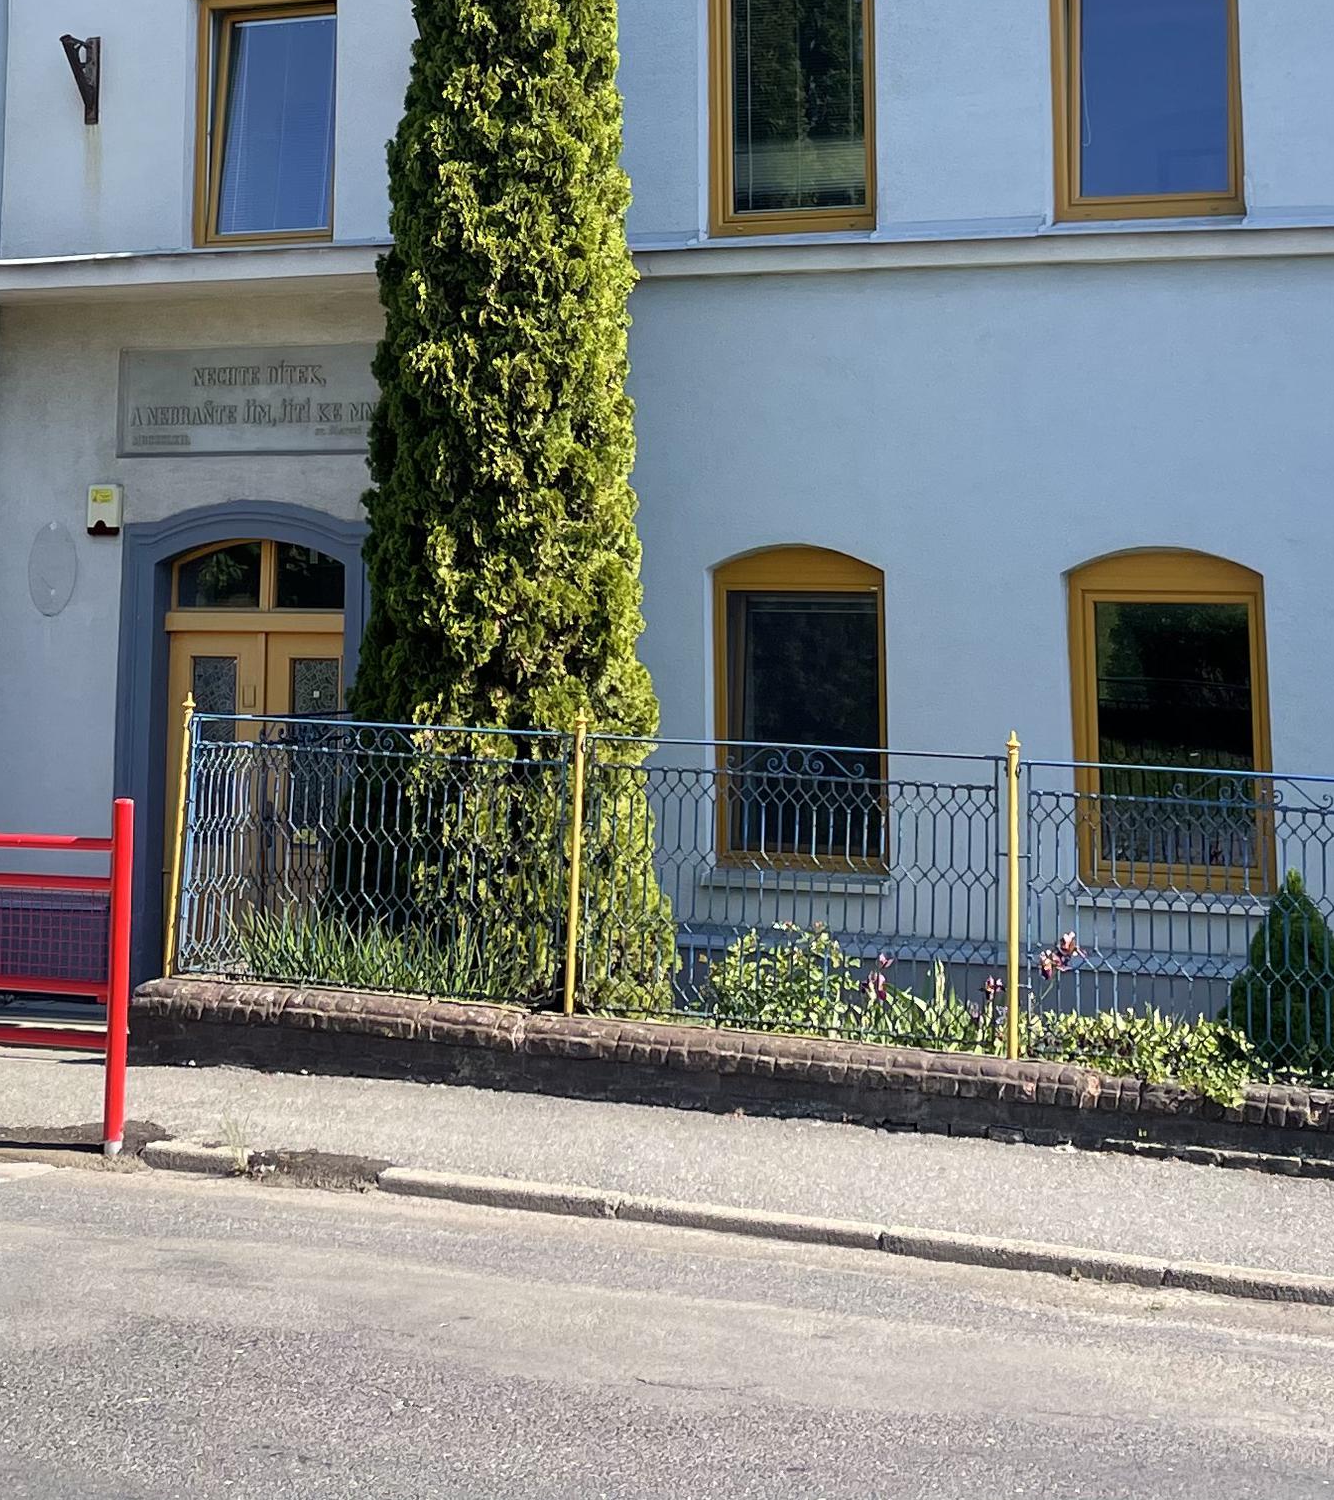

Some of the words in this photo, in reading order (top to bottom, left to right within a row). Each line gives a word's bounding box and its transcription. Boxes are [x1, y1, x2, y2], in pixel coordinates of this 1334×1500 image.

[193, 366, 261, 387] NECHTE
[266, 359, 327, 387] DÍTEK,
[130, 409, 143, 427] A
[147, 400, 238, 426] NEBRAŇTE
[316, 402, 343, 422] KE
